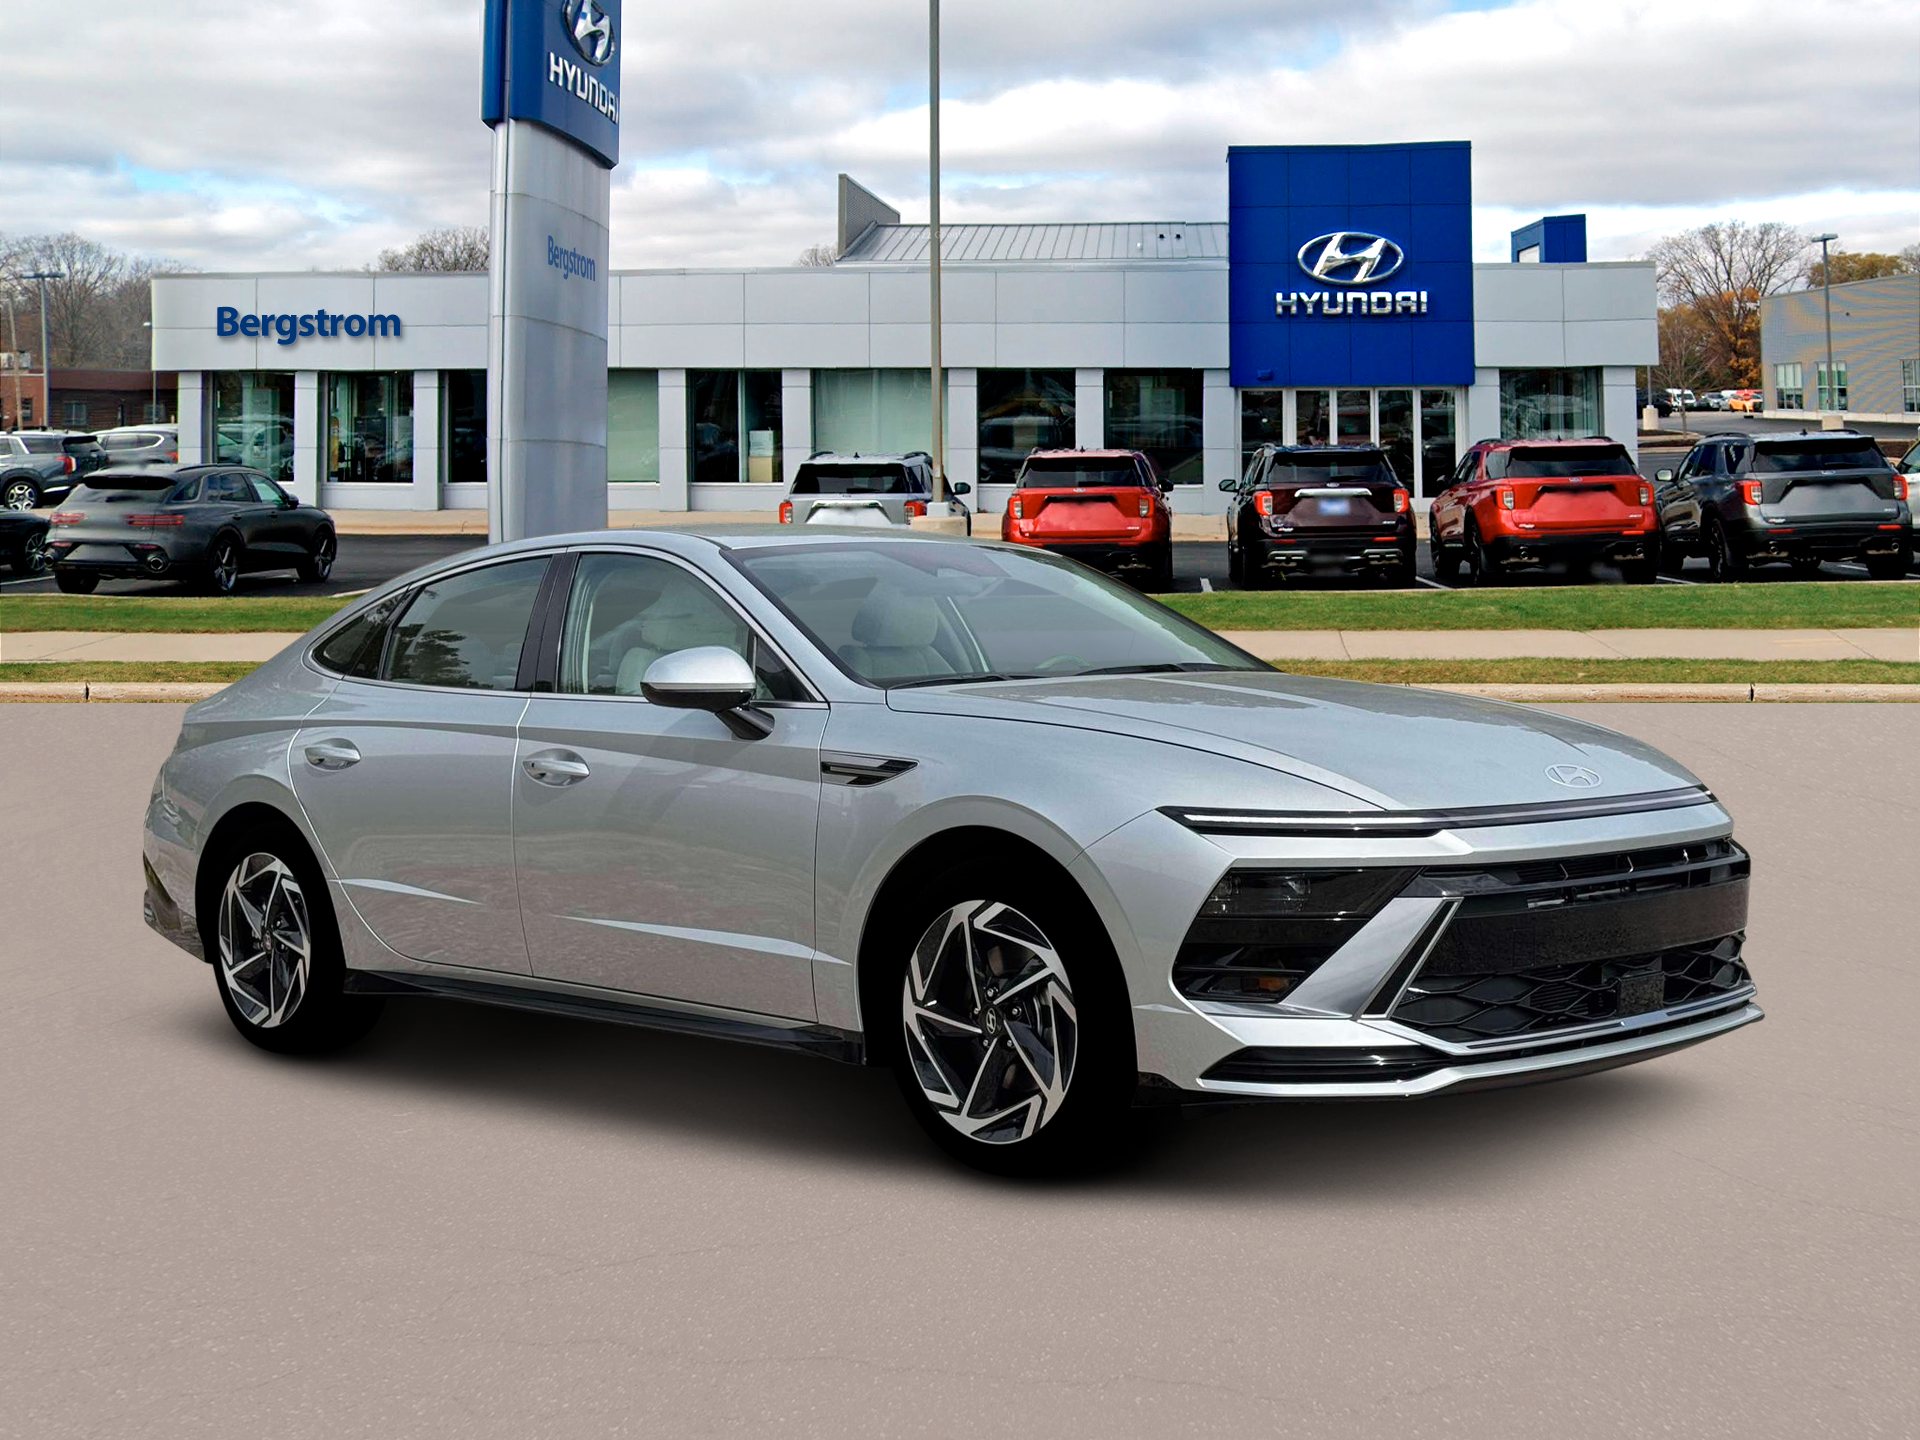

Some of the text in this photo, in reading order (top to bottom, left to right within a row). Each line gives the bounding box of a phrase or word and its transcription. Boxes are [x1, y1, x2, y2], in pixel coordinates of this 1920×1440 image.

[548, 52, 618, 124] HYUNDAI
[547, 235, 596, 282] Bergstrom
[1275, 290, 1428, 315] HYUNDAI
[216, 306, 401, 346] Bergstrom
